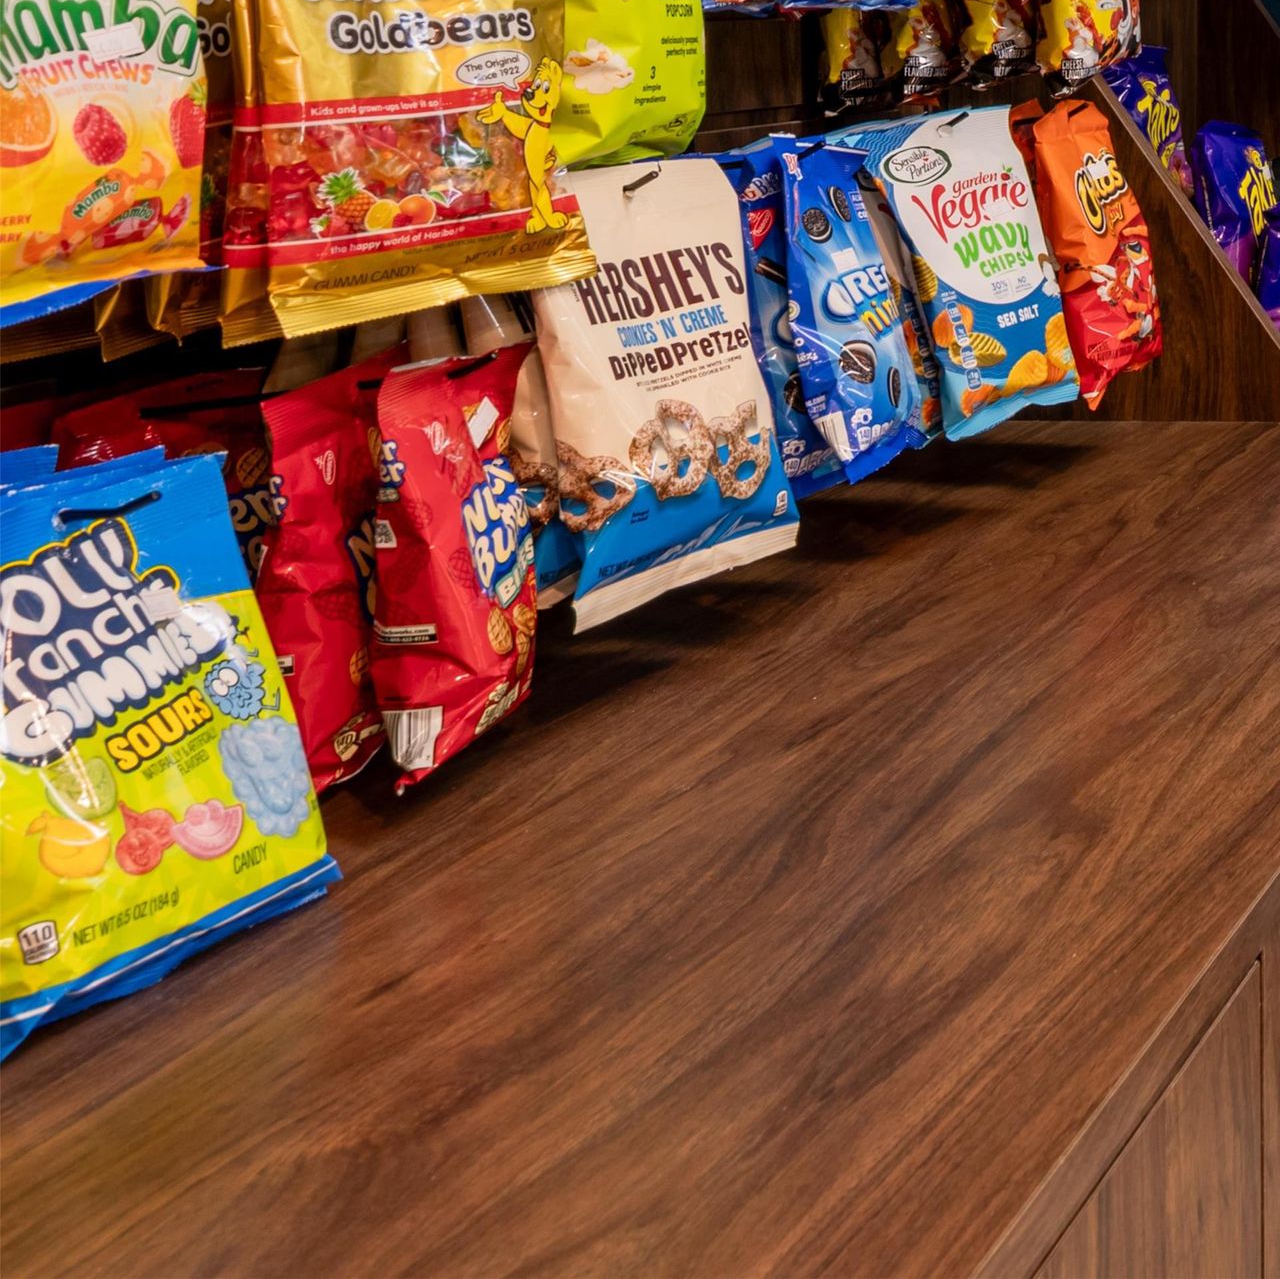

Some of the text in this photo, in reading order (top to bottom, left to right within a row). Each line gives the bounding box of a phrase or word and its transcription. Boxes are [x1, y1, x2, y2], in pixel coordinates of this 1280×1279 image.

[666, 4, 693, 17] POPCORN
[20, 54, 155, 89] FRUIT CHEWS
[465, 55, 520, 74] The Original
[500, 66, 520, 78] 1922
[650, 65, 656, 80] 3
[1062, 58, 1084, 70] CHEESE
[642, 83, 661, 93] simple
[310, 99, 439, 117] Kids and grown-ups love it so
[634, 95, 667, 107] ingredients
[892, 148, 929, 172] Sensible
[906, 155, 946, 180] Portions
[952, 171, 998, 198] garden
[72, 179, 120, 220] Mamba
[330, 233, 422, 256] the happy world of
[953, 223, 1035, 269] wavy
[371, 263, 419, 285] CANDY
[979, 252, 1028, 278] CHIPS
[575, 242, 745, 326] HERSHEY'S
[616, 322, 658, 349] COOKIES
[679, 304, 728, 334] CREME
[997, 304, 1040, 328] SEA SALT
[675, 367, 697, 379] DIPPED
[682, 373, 697, 384] WITH
[106, 688, 213, 774] SOURS
[233, 842, 268, 875] CANDY
[22, 924, 53, 949] 110
[73, 928, 97, 948] NET
[99, 919, 117, 936] WT
[133, 903, 148, 922] OZ
